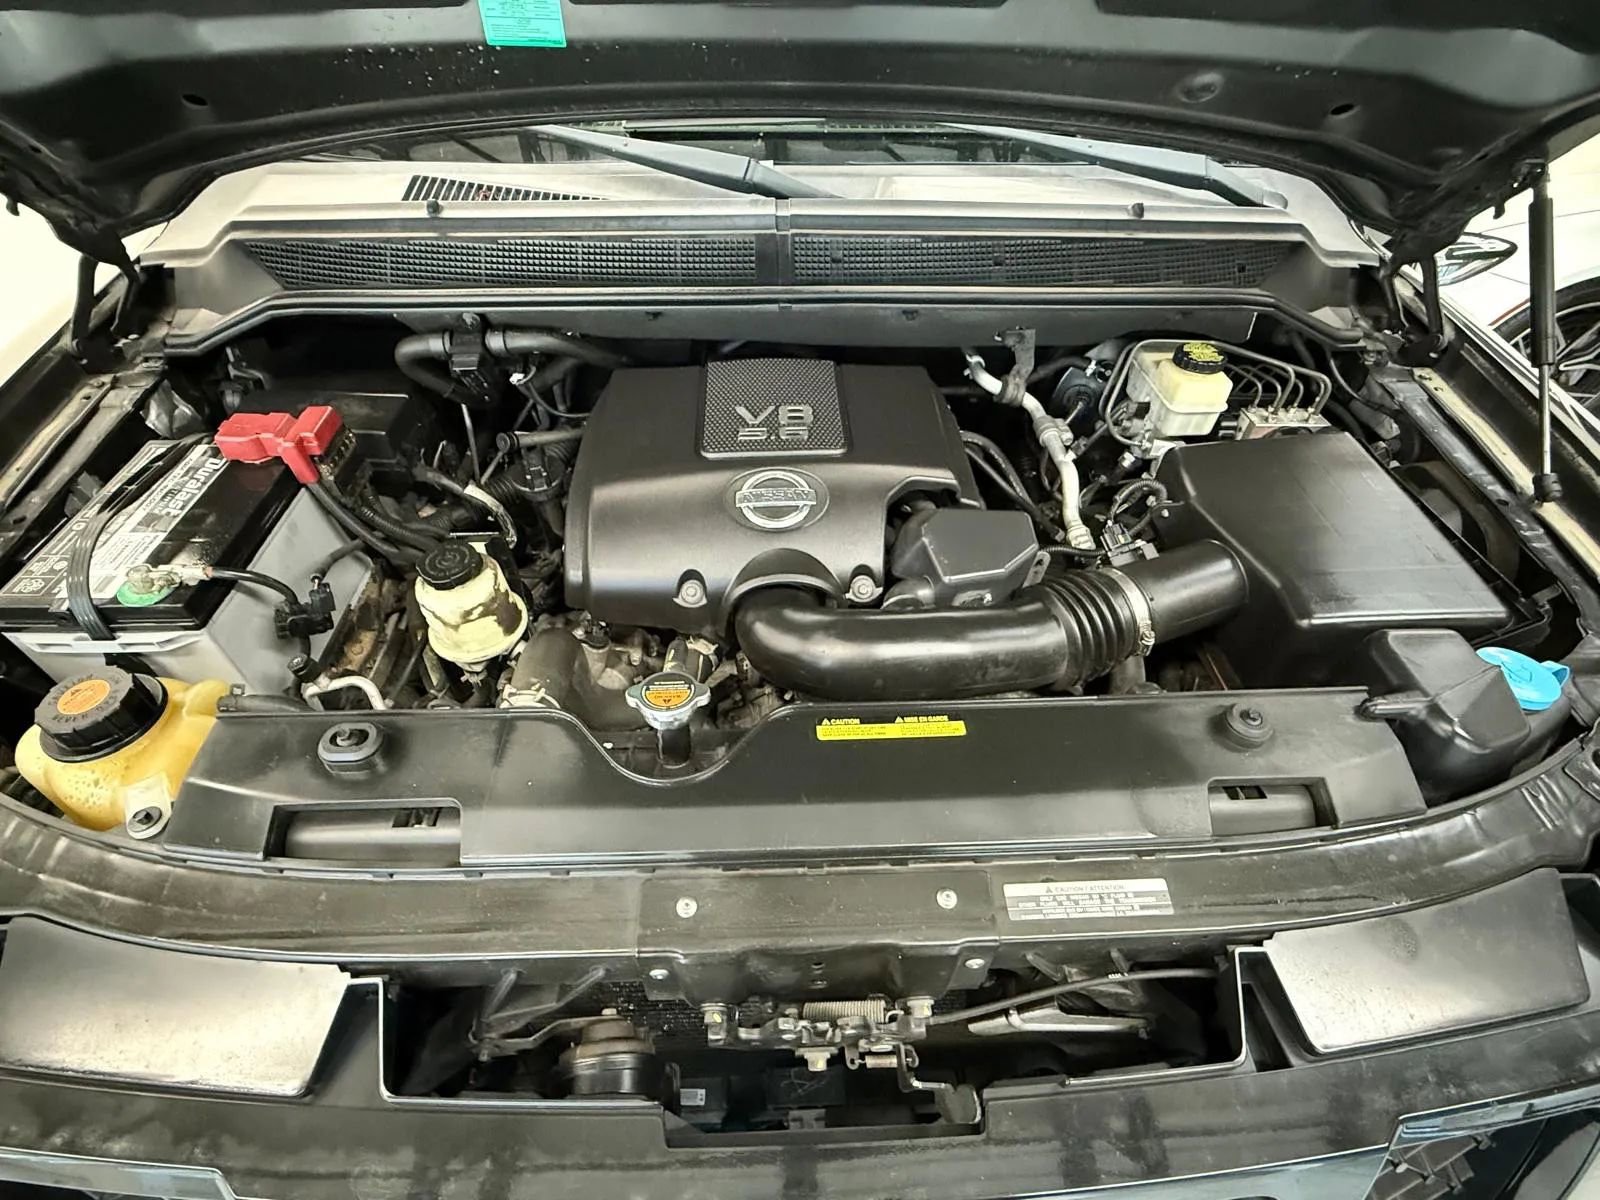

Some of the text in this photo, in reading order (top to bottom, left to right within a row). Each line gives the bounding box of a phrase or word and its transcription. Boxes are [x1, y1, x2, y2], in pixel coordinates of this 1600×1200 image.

[735, 404, 814, 424] V8
[738, 427, 808, 441] 5.6
[160, 456, 227, 518] Duralast
[742, 488, 810, 502] NISSAN
[1055, 885, 1084, 893] CAUTION
